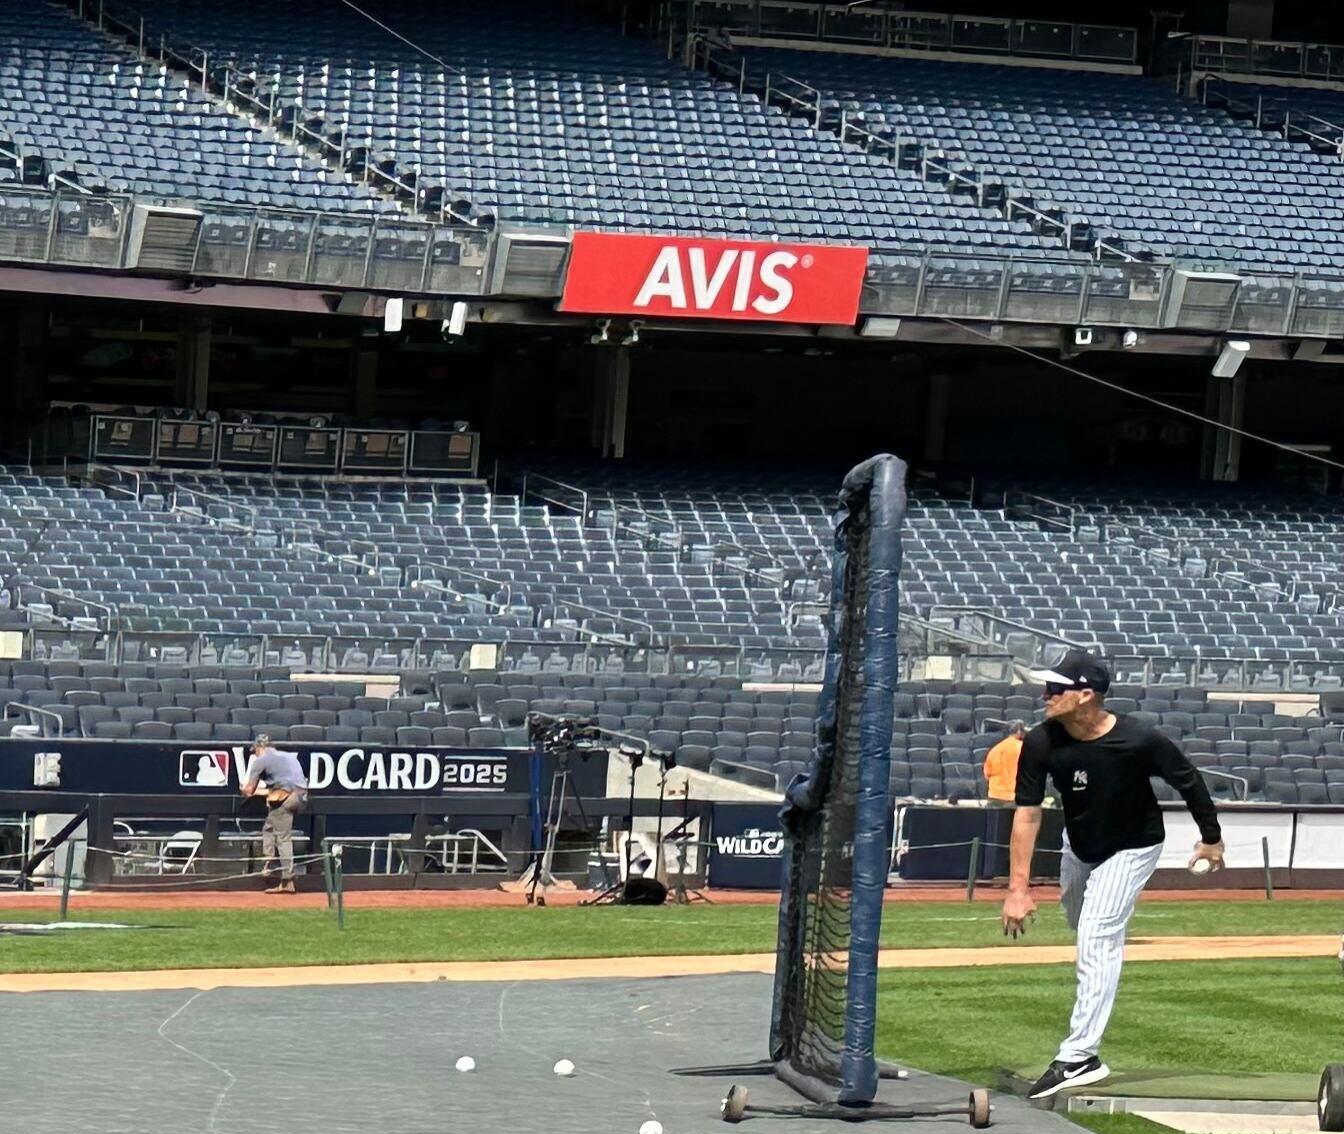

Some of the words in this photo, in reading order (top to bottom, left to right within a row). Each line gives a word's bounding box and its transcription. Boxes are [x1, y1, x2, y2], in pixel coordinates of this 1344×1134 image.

[633, 246, 798, 314] AVIS
[232, 747, 441, 790] WDCARD
[443, 764, 507, 783] 2025
